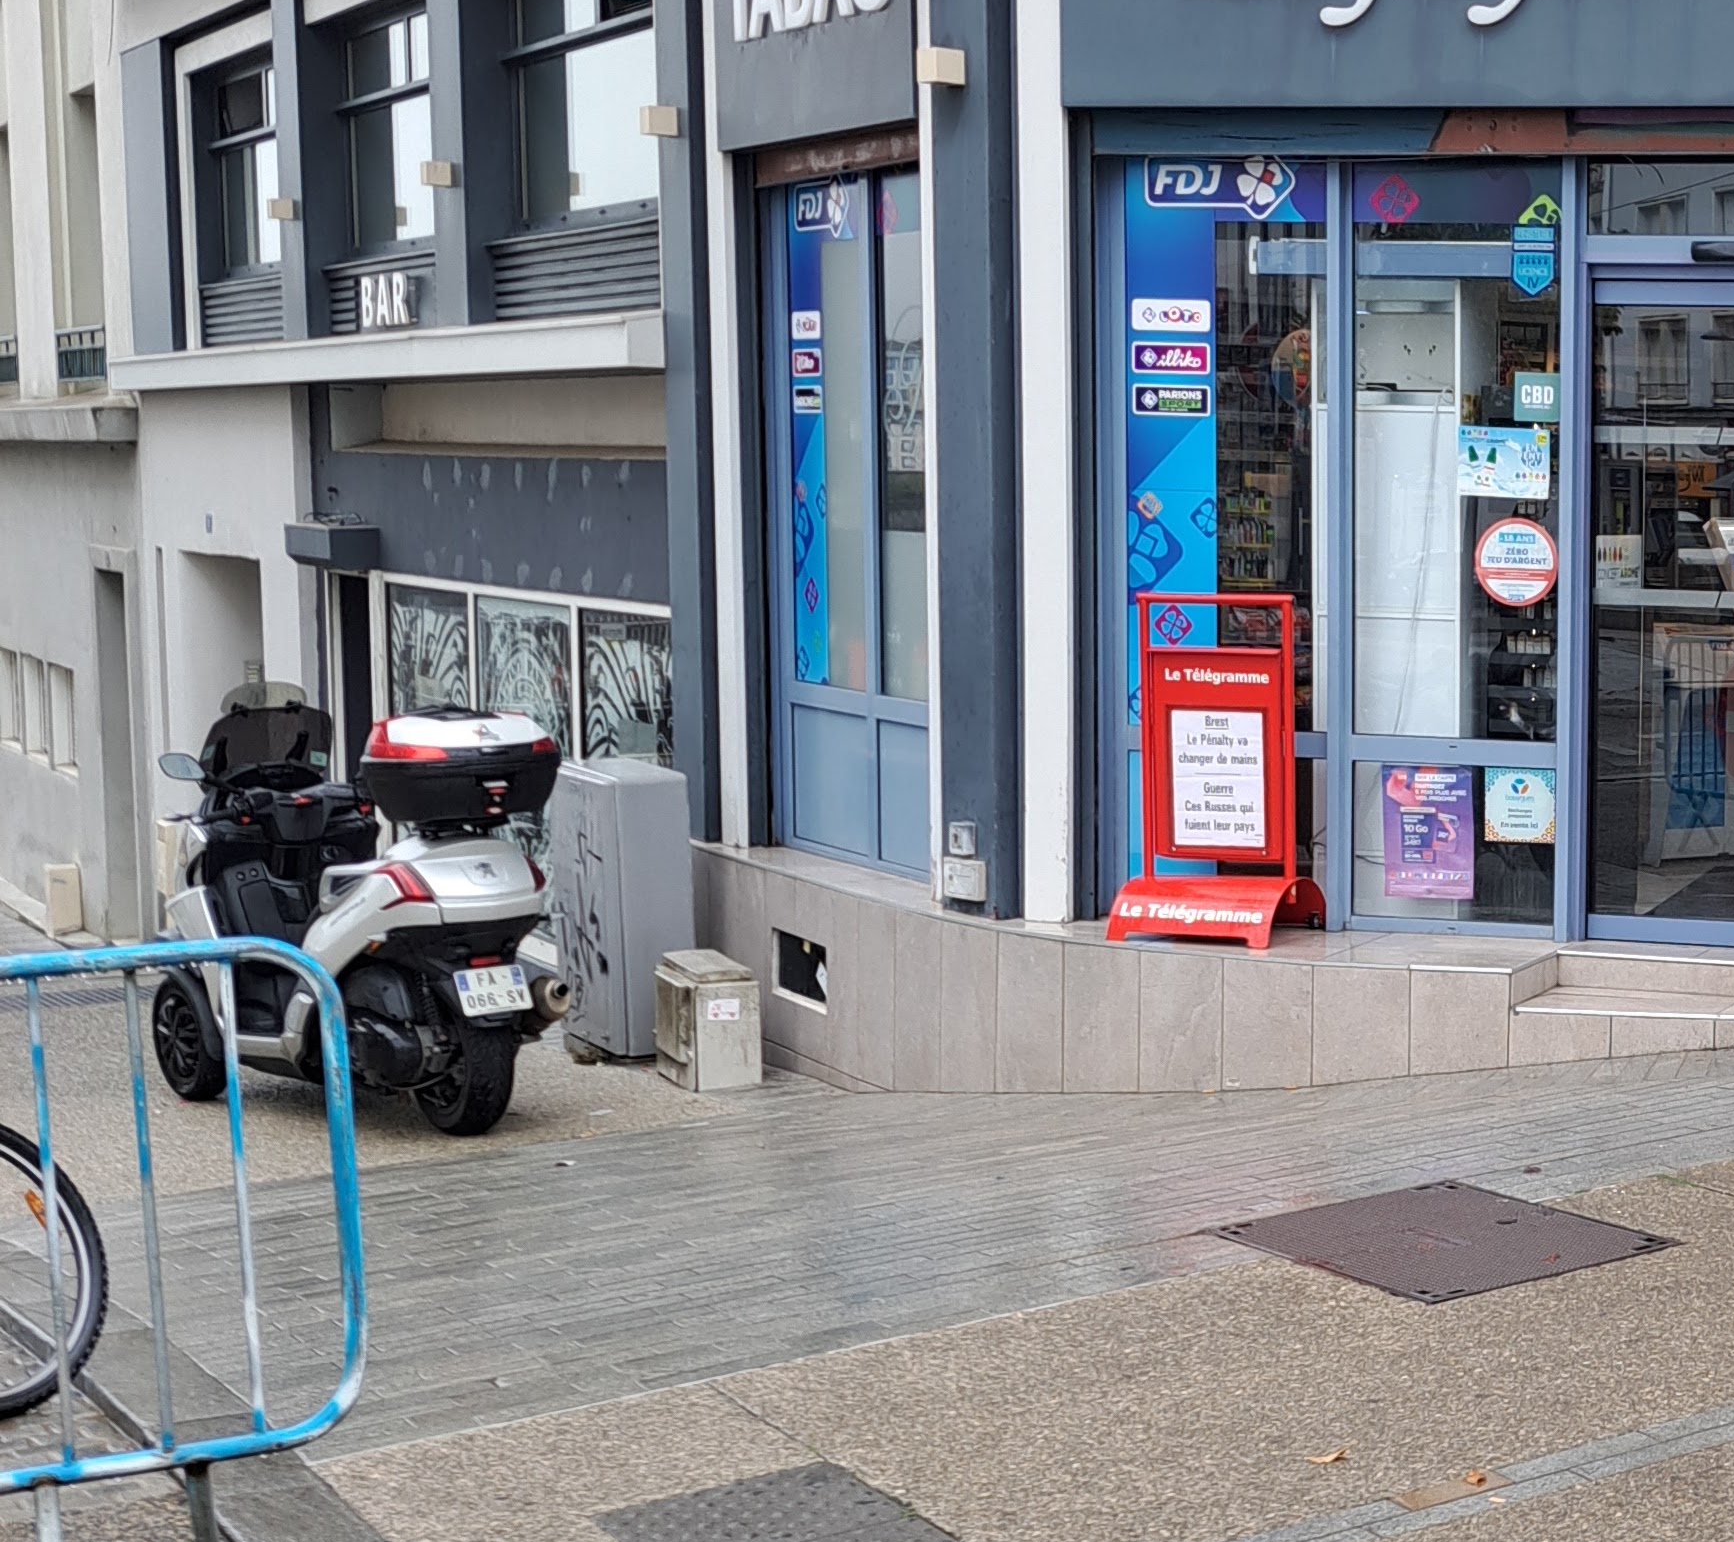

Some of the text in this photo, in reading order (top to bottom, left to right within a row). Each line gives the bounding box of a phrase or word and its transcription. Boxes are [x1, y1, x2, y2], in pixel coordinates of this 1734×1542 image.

[1153, 164, 1224, 197] FDJ
[797, 191, 823, 222] FDJ
[360, 272, 411, 328] BAR
[1158, 306, 1203, 324] LOTO
[1156, 348, 1203, 369] illiko
[1158, 389, 1203, 401] PARIONS
[1521, 384, 1555, 405] CBD
[1160, 400, 1201, 409] SPORT
[1505, 547, 1529, 556] ZÉRO
[1164, 667, 1270, 686] Le Télégramme
[1204, 715, 1230, 727] Brest
[1187, 733, 1249, 750] Le Pénalty va
[1178, 752, 1259, 768] changer de mains
[1203, 781, 1235, 796] Guerre
[1184, 800, 1254, 816] Ces Russes qui
[1184, 818, 1255, 837] fuient leur pays
[1403, 823, 1429, 833] 10 Go
[1119, 901, 1263, 925] Le Télégramme
